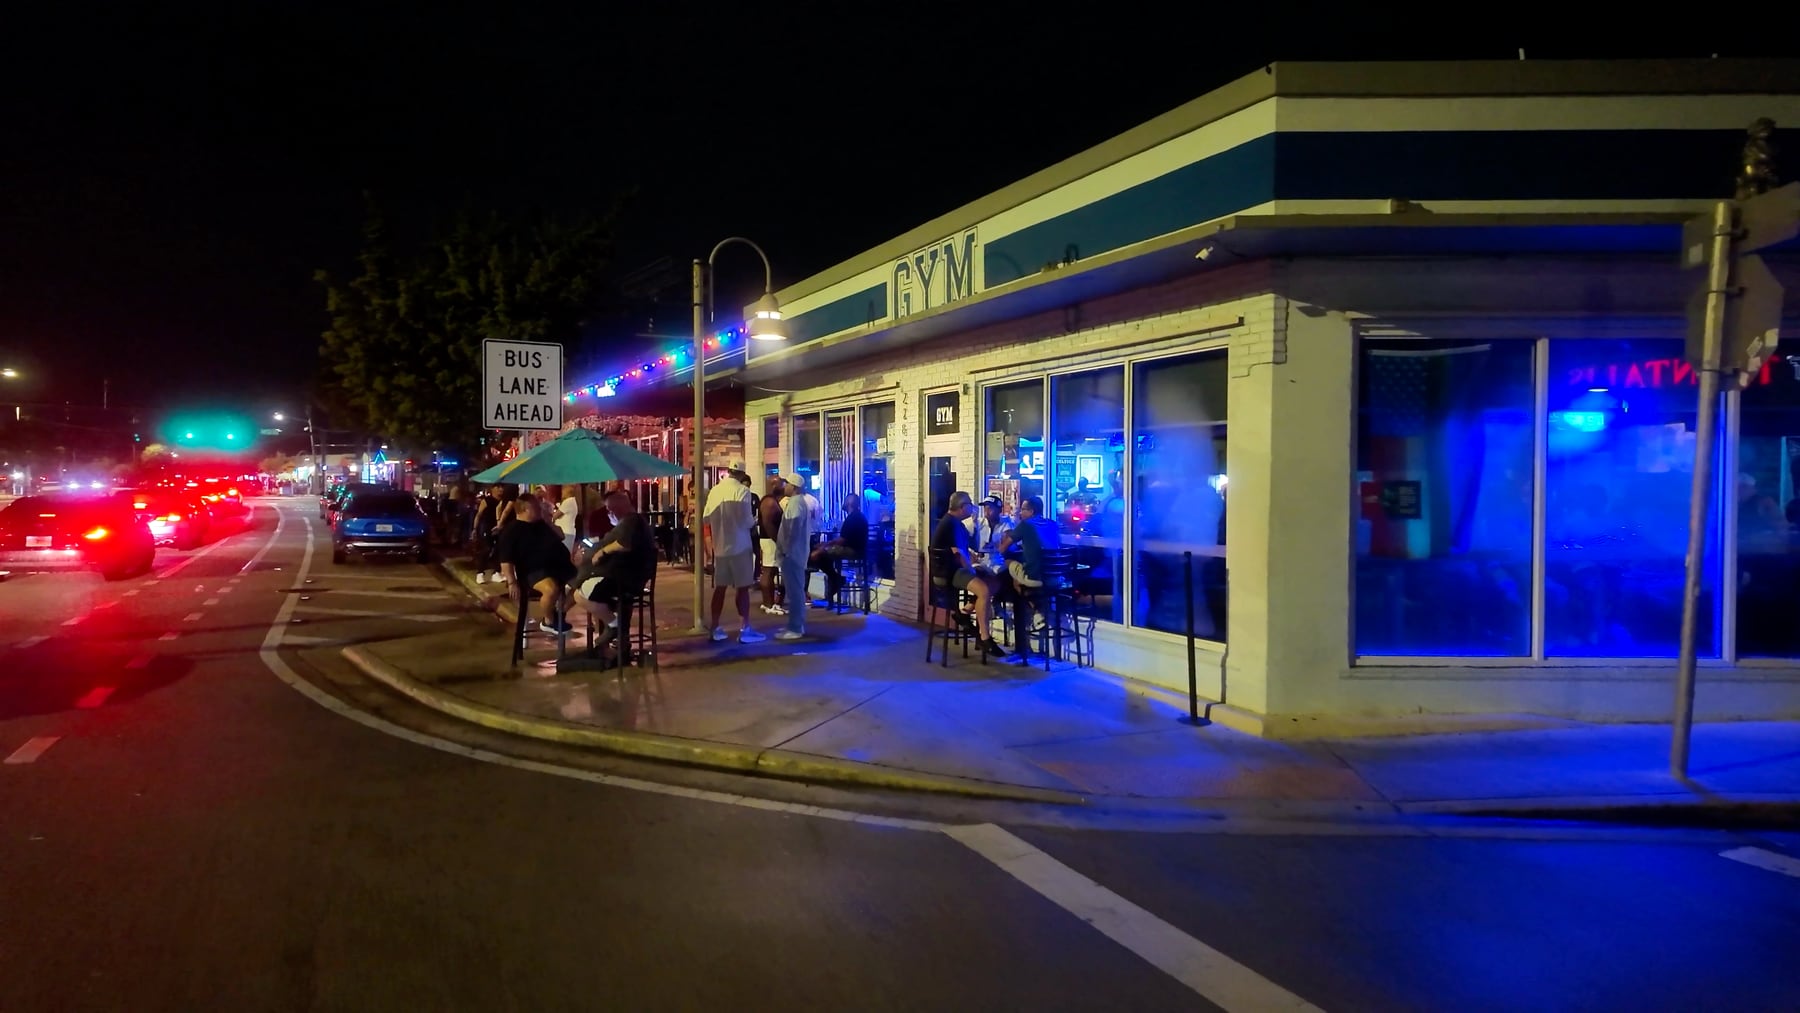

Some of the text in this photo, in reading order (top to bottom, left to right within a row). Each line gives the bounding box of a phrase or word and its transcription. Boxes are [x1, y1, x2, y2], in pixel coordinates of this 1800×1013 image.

[892, 226, 978, 320] GYM
[505, 350, 542, 368] BUS
[500, 376, 547, 395] LANE
[494, 403, 553, 422] AHEAD
[936, 406, 953, 422] GYM
